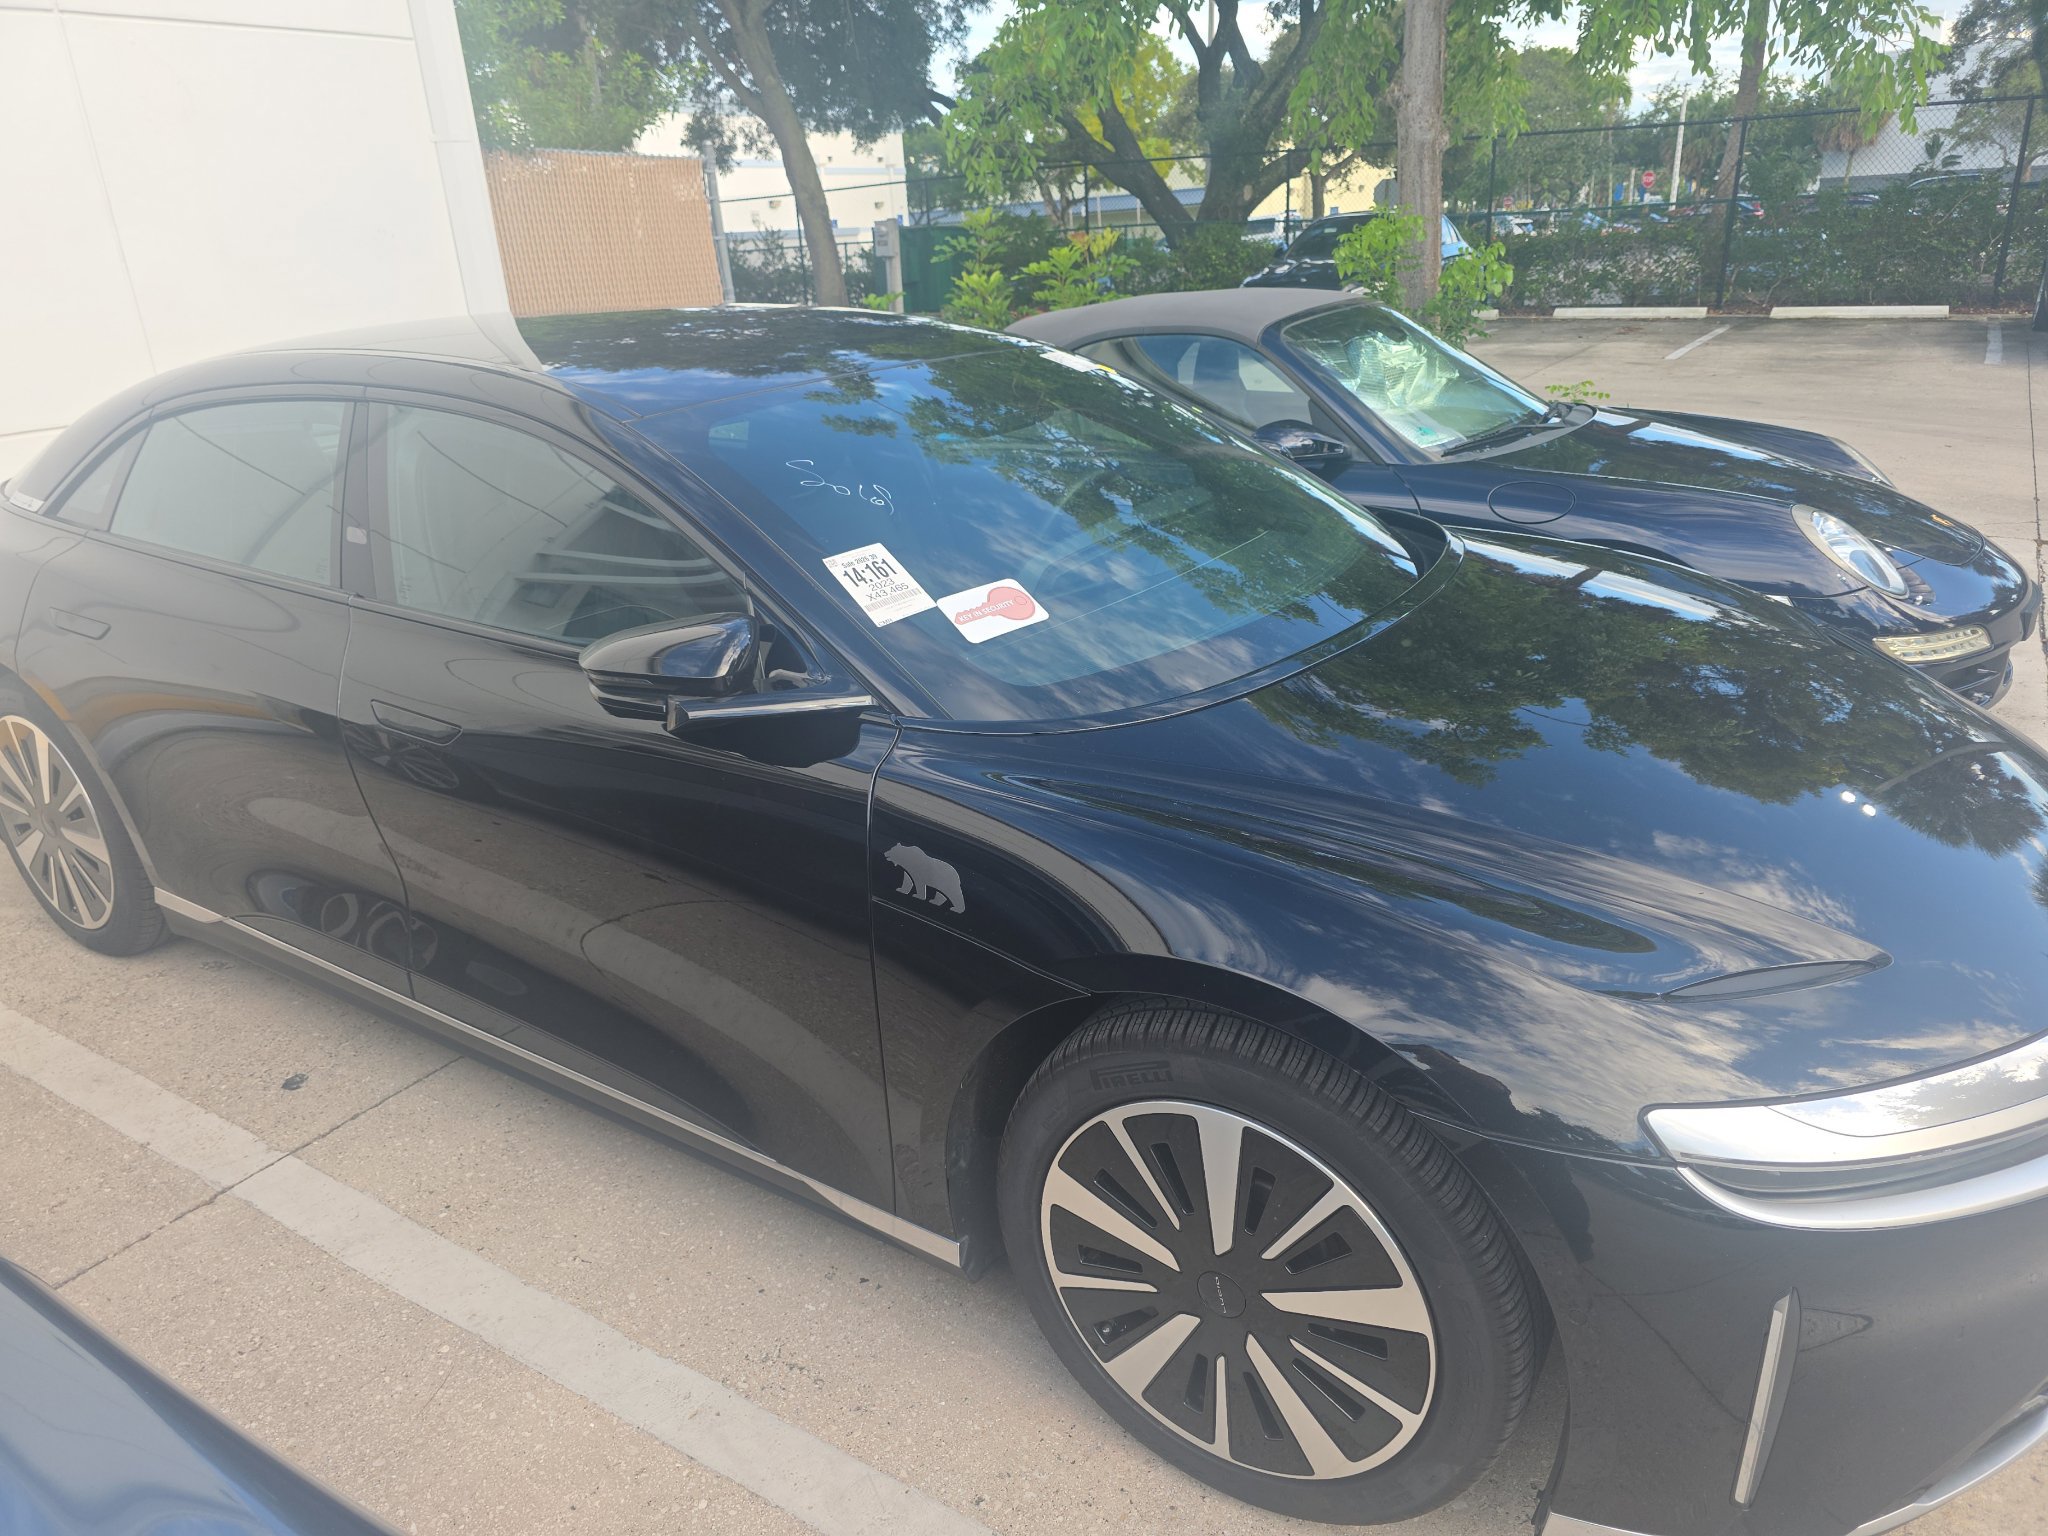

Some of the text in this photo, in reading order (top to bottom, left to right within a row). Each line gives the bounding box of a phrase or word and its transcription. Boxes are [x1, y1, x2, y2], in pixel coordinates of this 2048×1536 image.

[841, 561, 855, 569] Sale
[842, 558, 898, 587] 14:161
[868, 577, 896, 592] 2023
[959, 613, 973, 622] KEY
[983, 600, 1015, 615] SECURITY
[1089, 1061, 1174, 1090] PIRELLI
